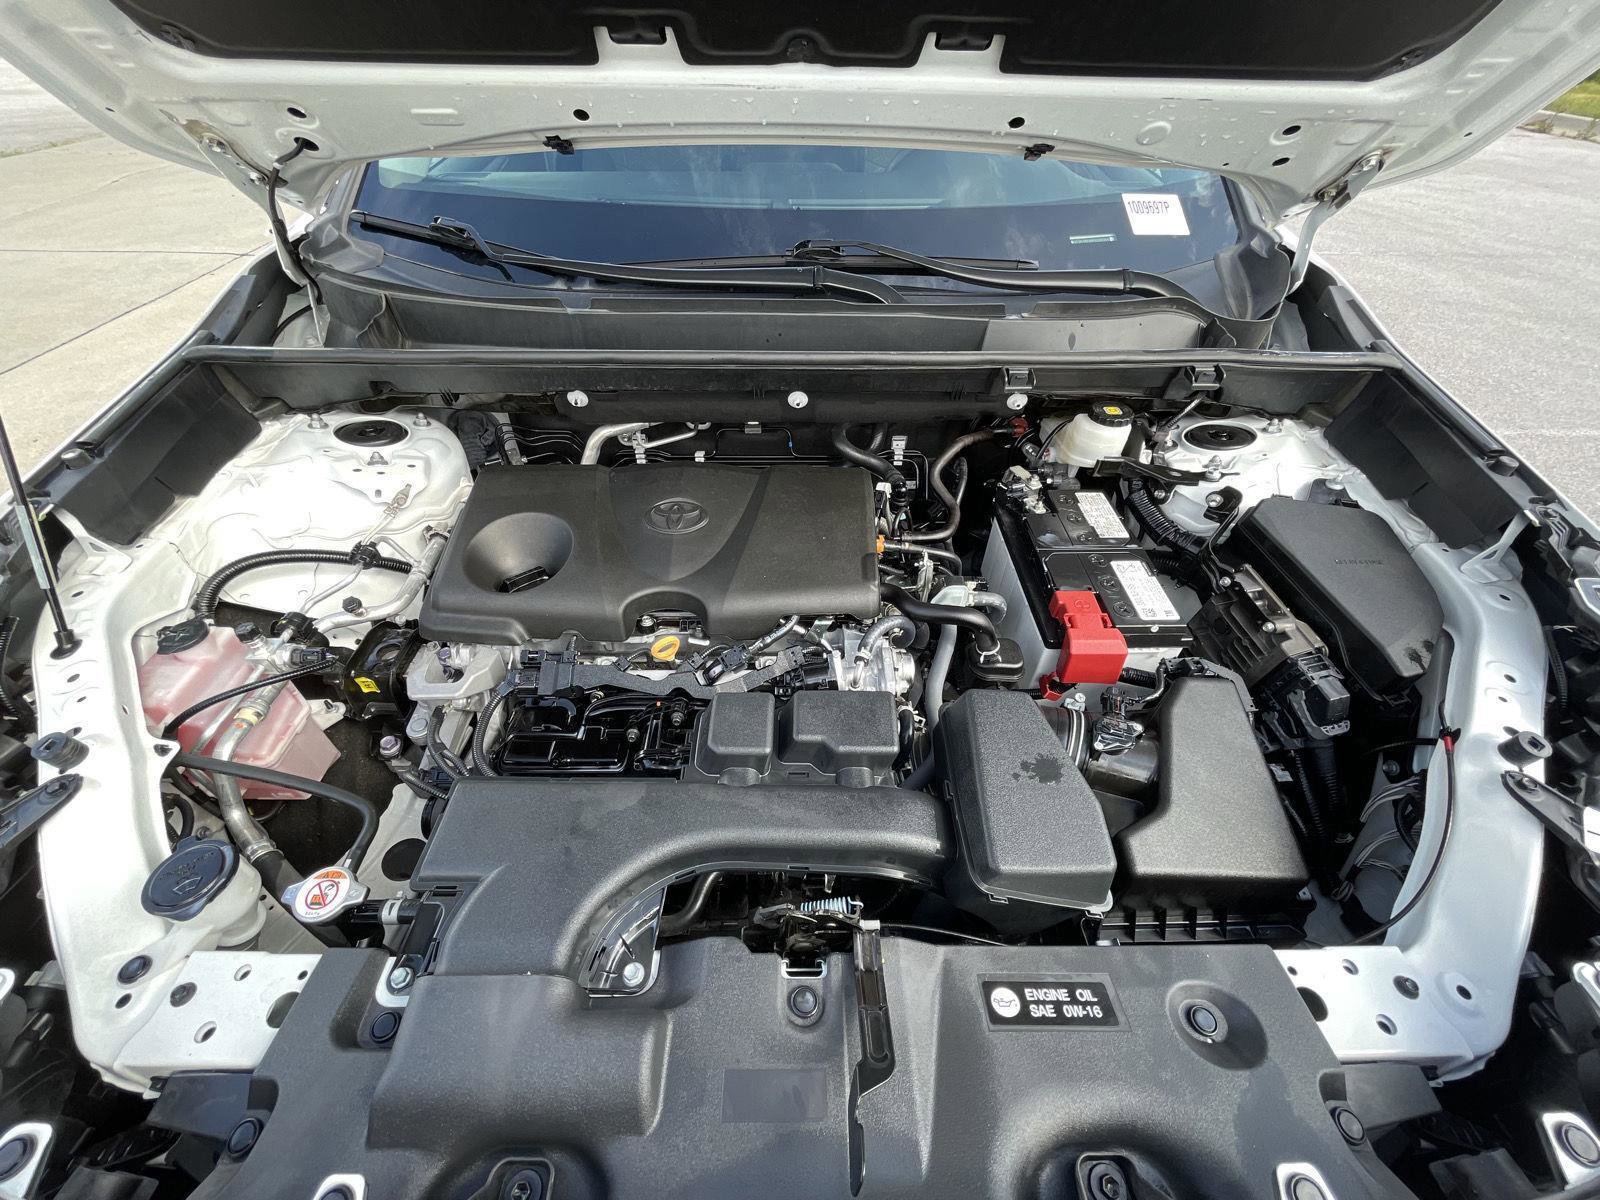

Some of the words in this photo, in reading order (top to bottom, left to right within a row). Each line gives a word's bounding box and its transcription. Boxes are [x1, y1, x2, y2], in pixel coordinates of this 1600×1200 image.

[1024, 988, 1070, 1001] ENGINE
[1075, 989, 1098, 1002] OIL
[1029, 1004, 1057, 1018] SAE
[1063, 1005, 1103, 1019] 0W-16
